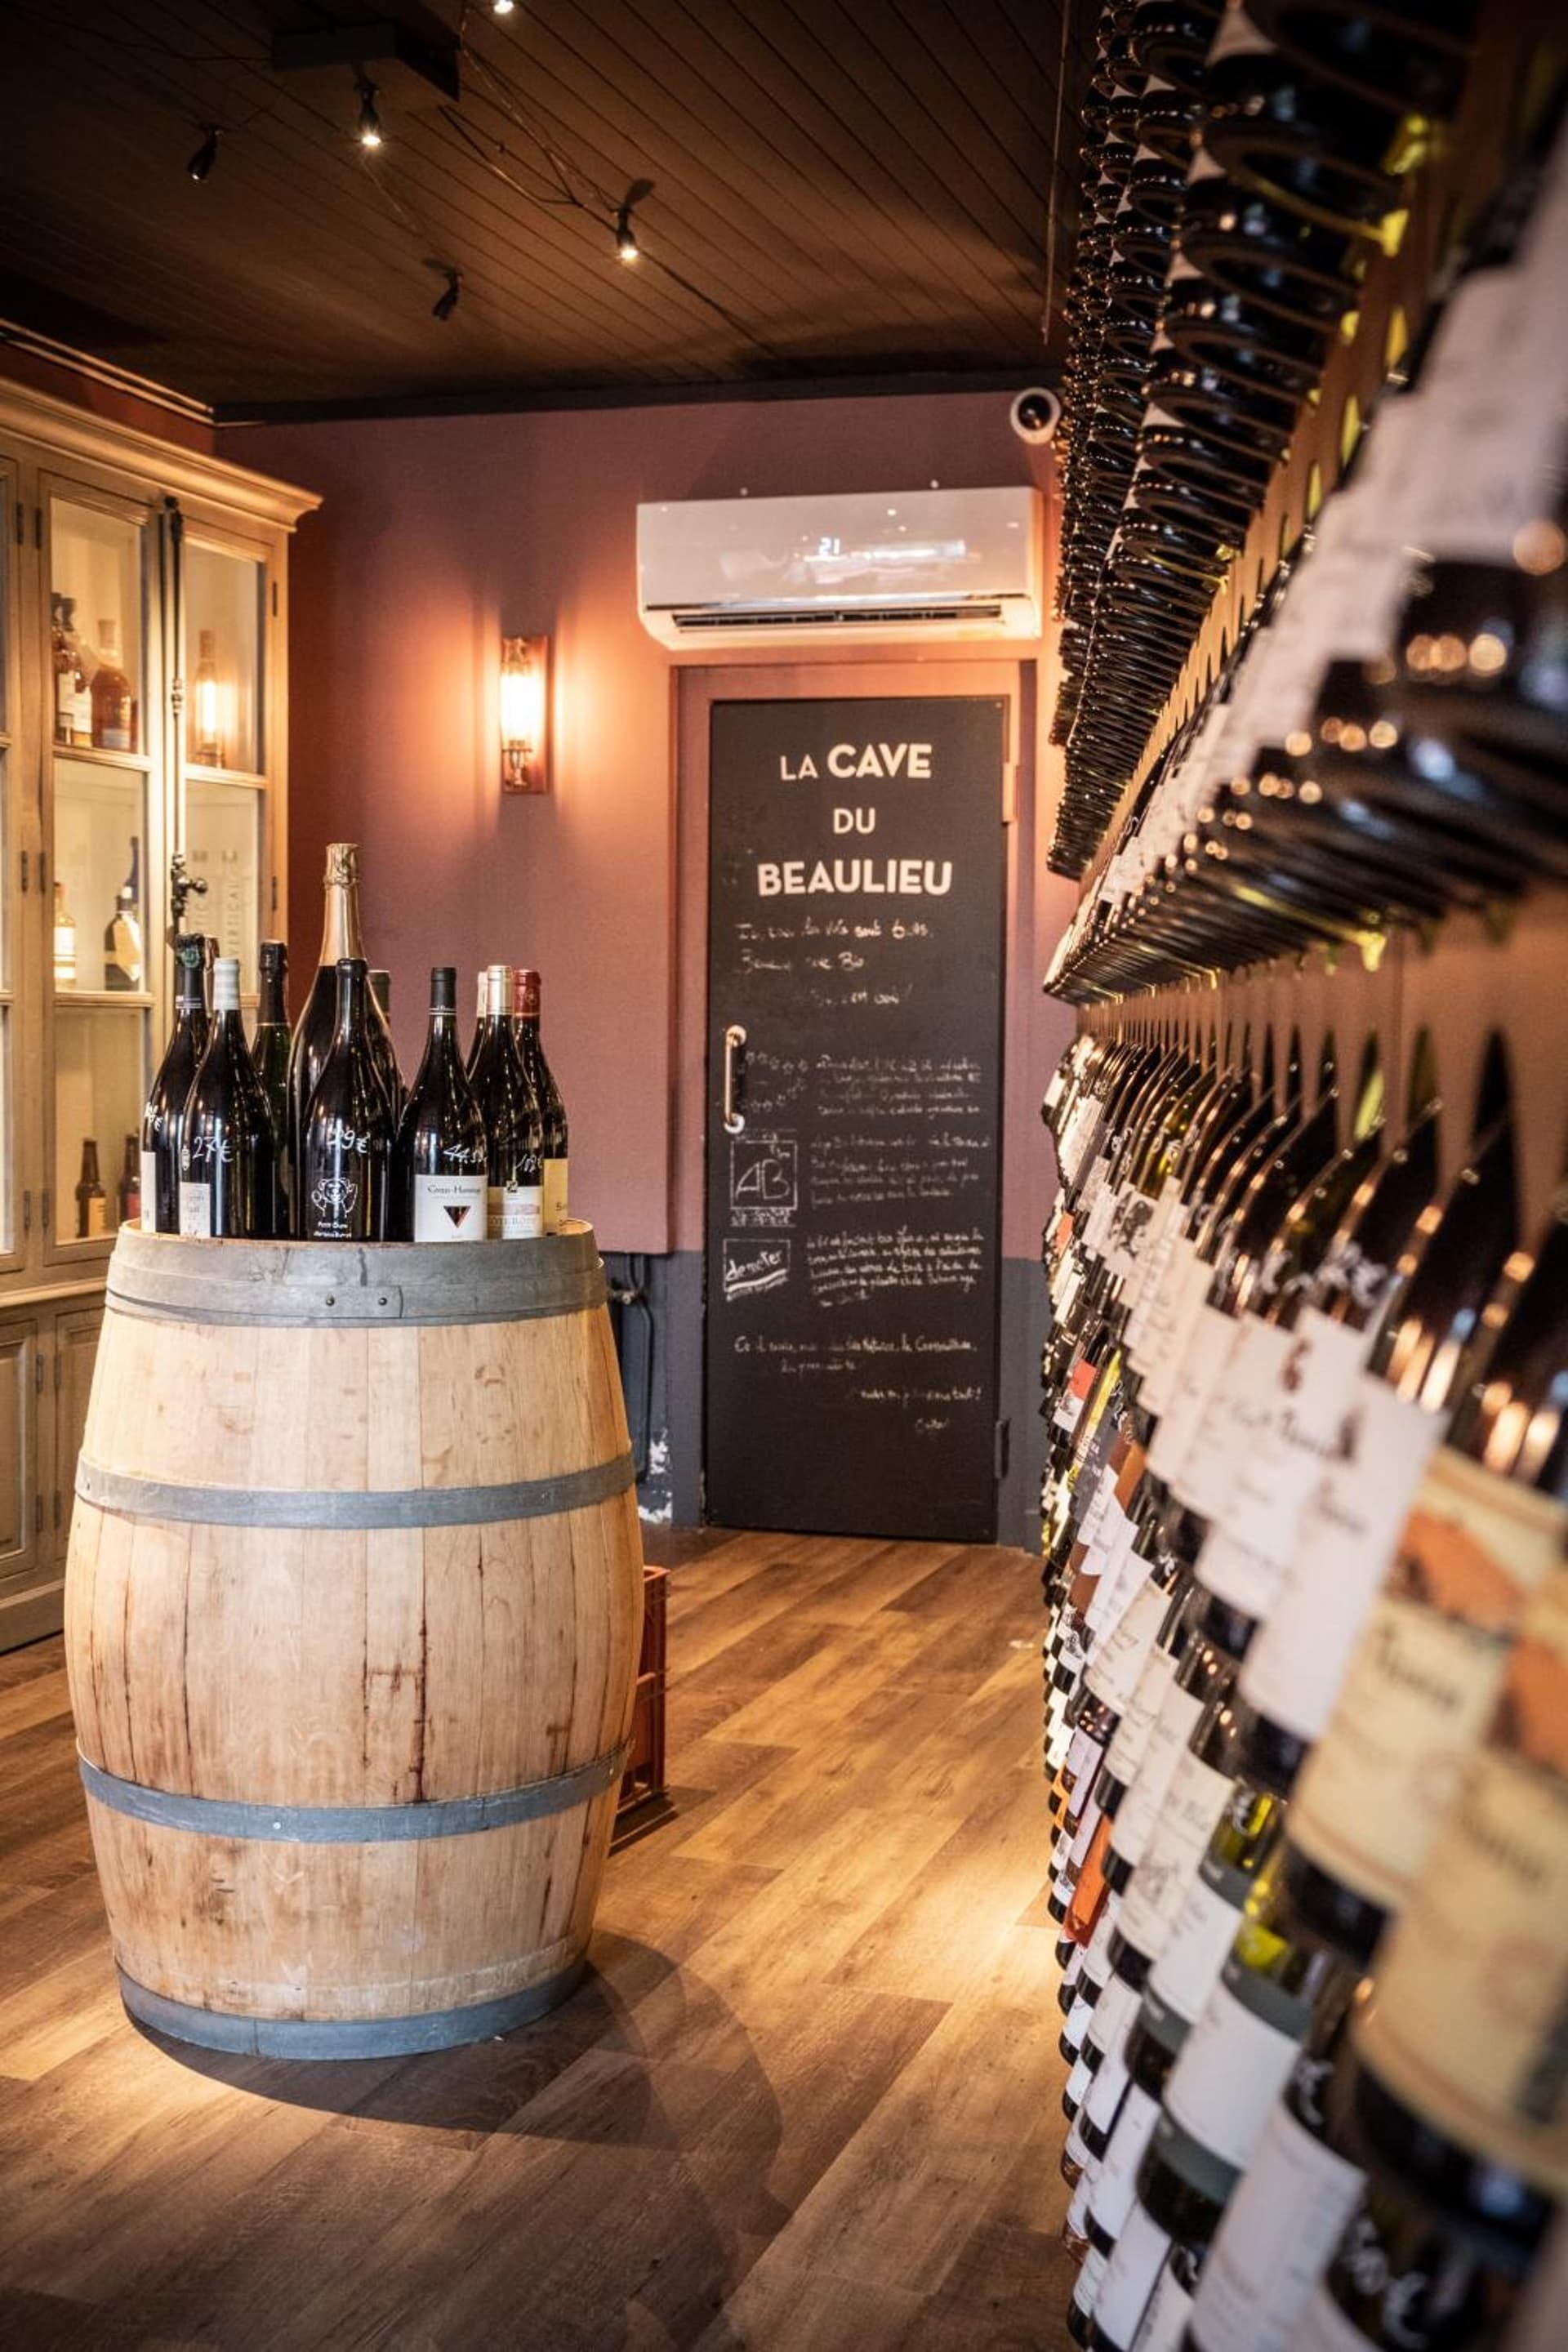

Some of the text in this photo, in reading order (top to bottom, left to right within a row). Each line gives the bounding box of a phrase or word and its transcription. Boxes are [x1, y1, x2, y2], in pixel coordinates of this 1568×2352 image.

[780, 743, 933, 781] LA CAVE
[833, 807, 876, 835] DU
[757, 859, 953, 897] BEAULIEU
